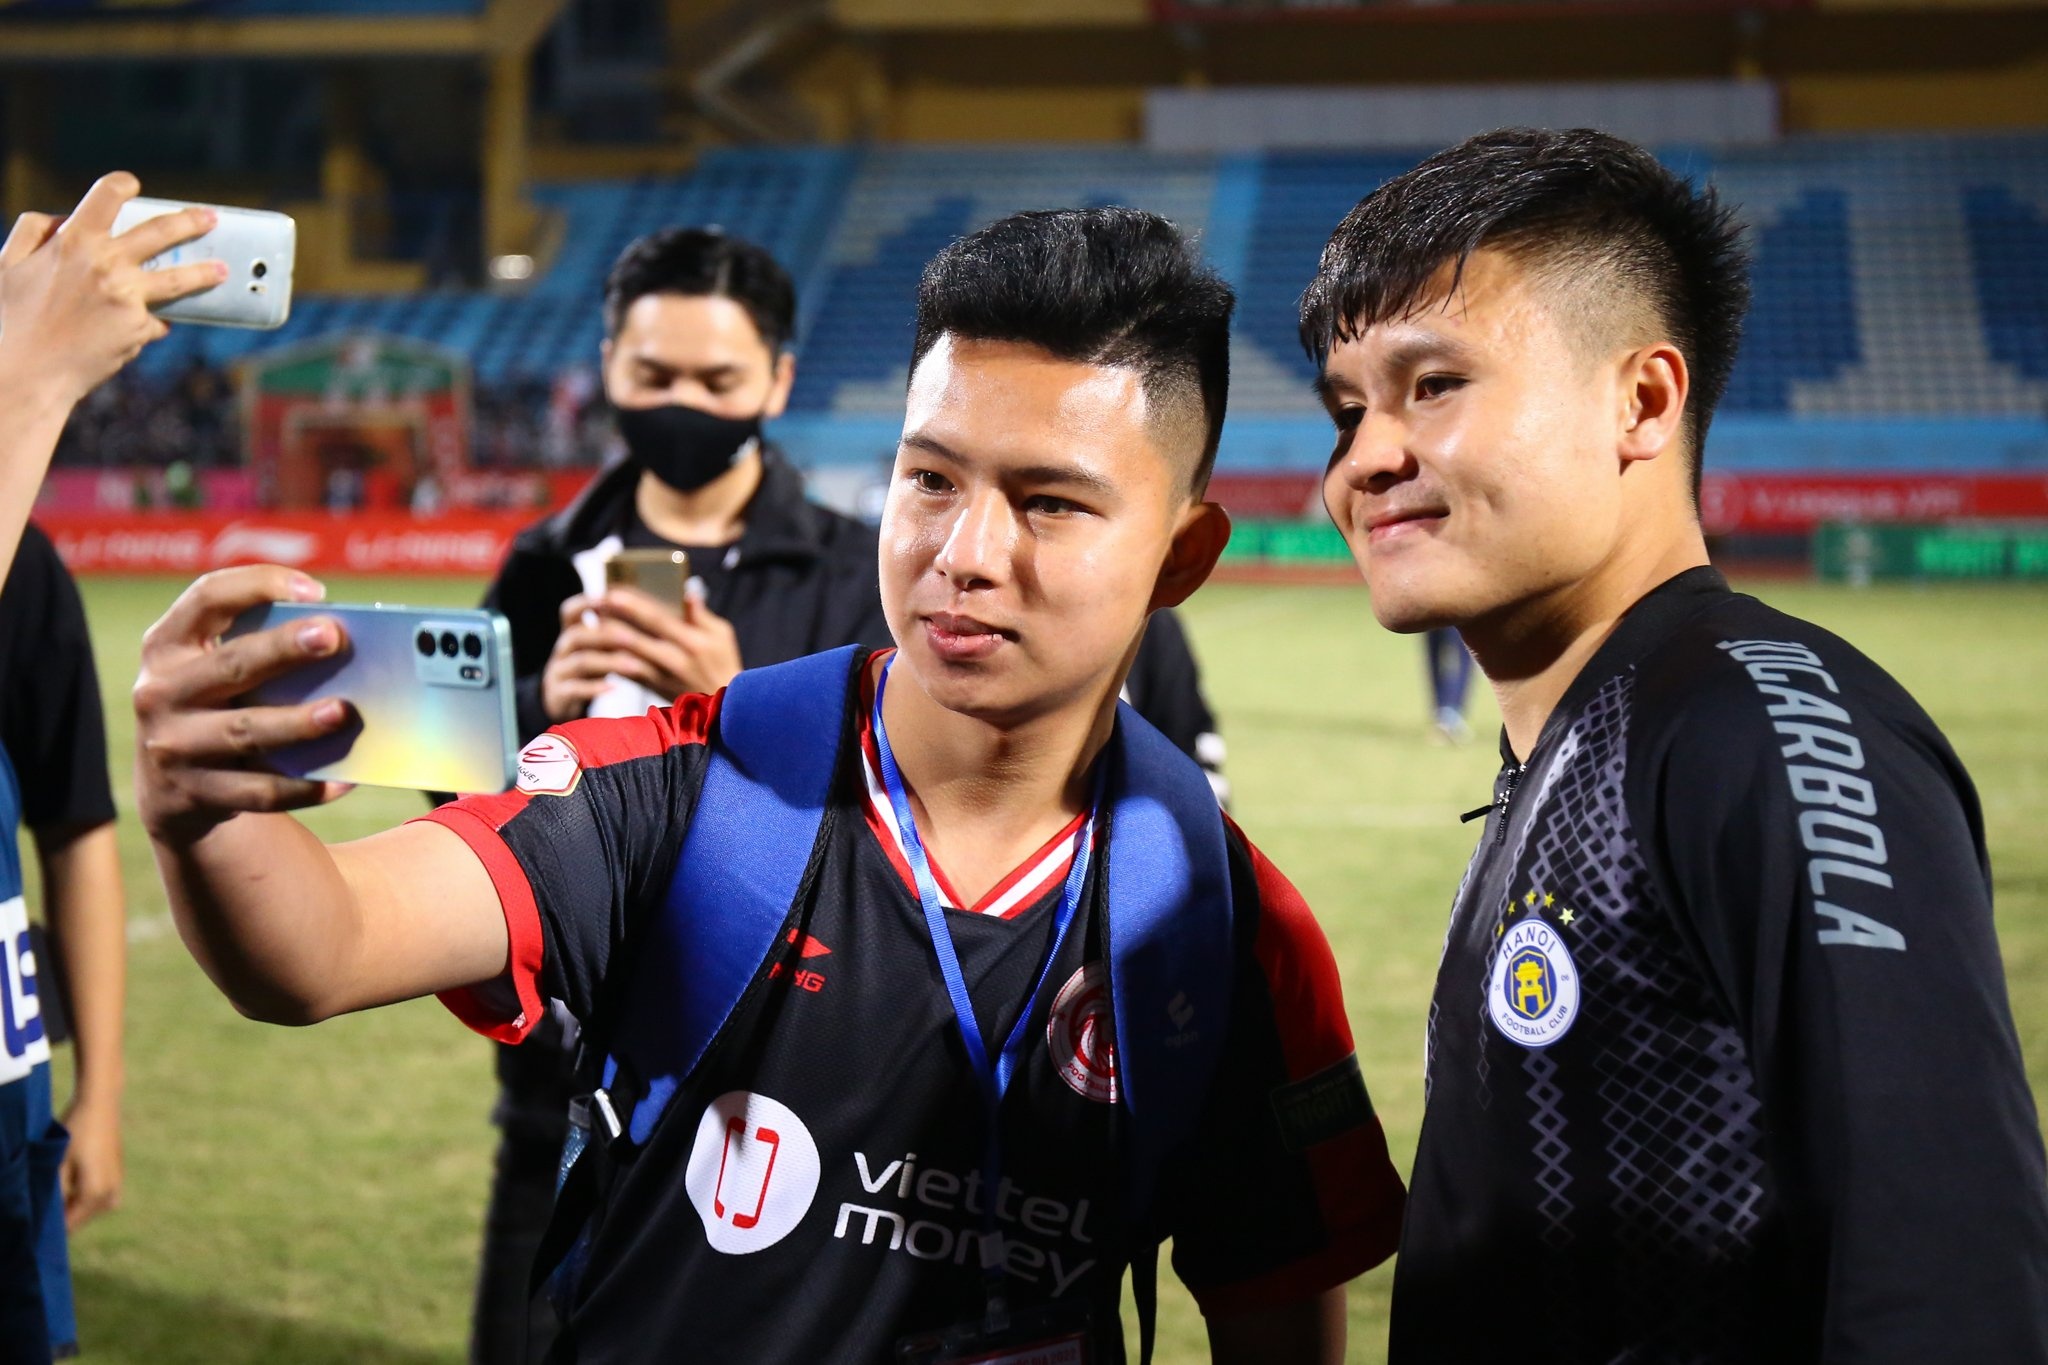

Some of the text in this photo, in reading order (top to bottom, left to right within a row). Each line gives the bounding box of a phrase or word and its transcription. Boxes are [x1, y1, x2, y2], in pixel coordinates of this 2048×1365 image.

[1503, 926, 1556, 960] HANOI
[1502, 1005, 1569, 1036] FOOTBALL CLUB
[853, 1151, 1093, 1243] viettel
[833, 1202, 1096, 1298] money
